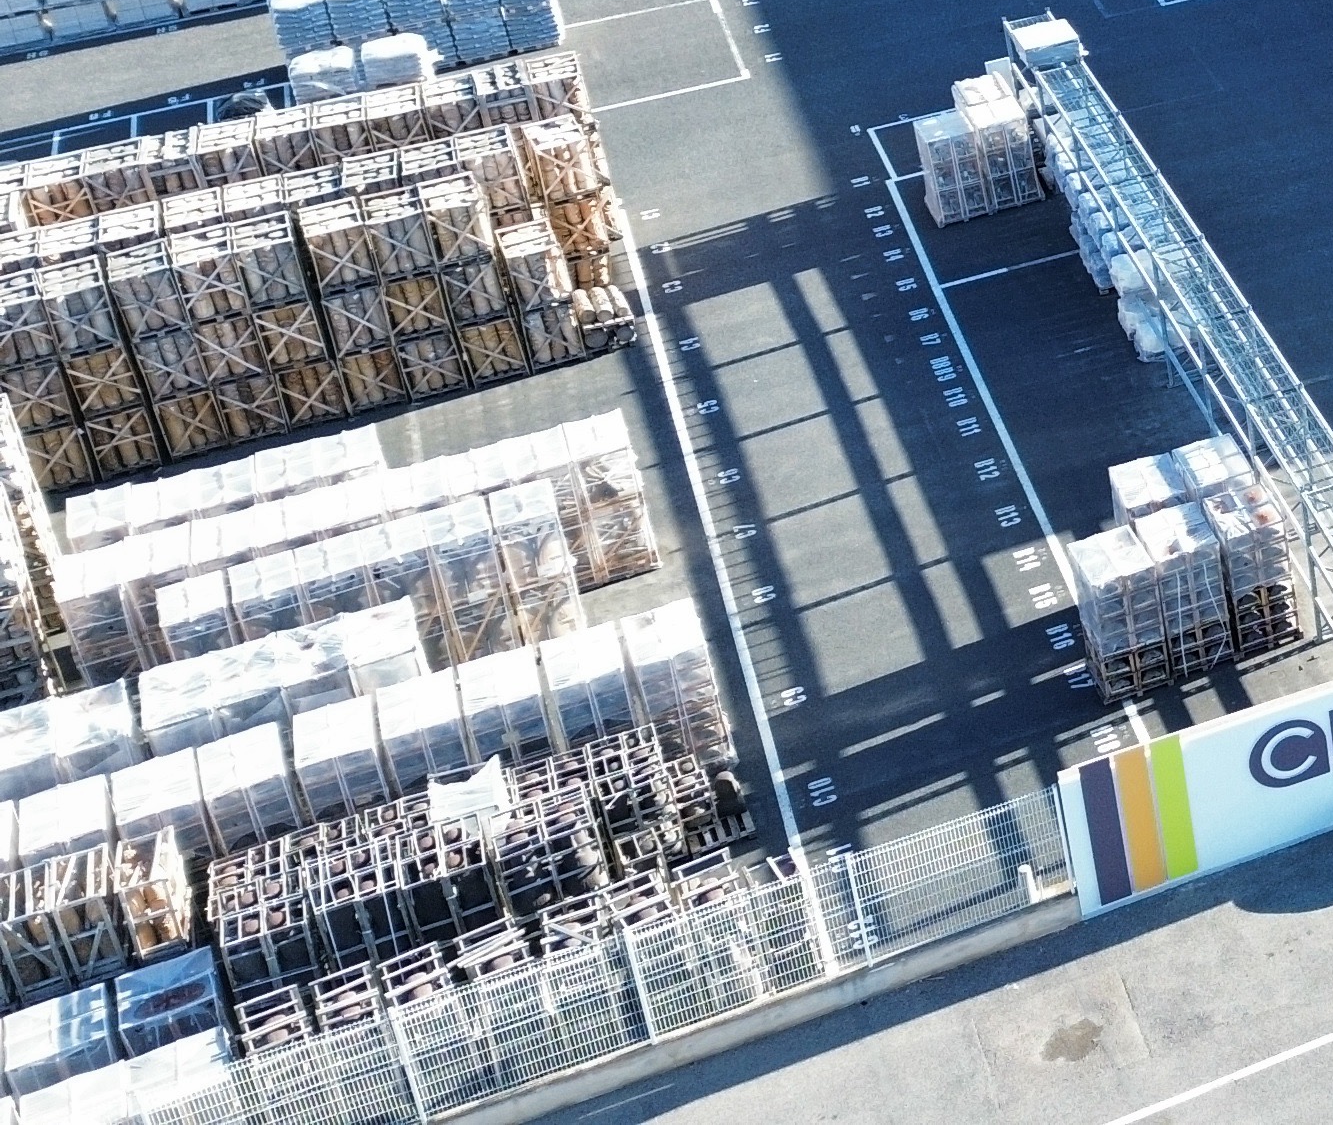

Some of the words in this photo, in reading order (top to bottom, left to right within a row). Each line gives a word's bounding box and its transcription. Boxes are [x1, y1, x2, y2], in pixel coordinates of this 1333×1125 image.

[864, 205, 885, 219] B2
[872, 225, 893, 239] B3
[882, 248, 905, 263] B4
[661, 279, 684, 294] C3
[895, 277, 917, 293] B5
[908, 307, 930, 322] B6
[678, 336, 701, 352] C4
[919, 332, 942, 346] B7
[942, 386, 968, 408] B10
[697, 399, 720, 415] C5
[956, 416, 981, 437] B11
[717, 468, 741, 485] C6
[973, 457, 1000, 482] B12
[994, 504, 1022, 528] B13
[733, 524, 757, 540] C7
[1012, 546, 1041, 572] B14
[1028, 582, 1058, 610] B15
[1045, 623, 1076, 651] B16
[781, 686, 807, 707] C9
[807, 777, 838, 807] C10
